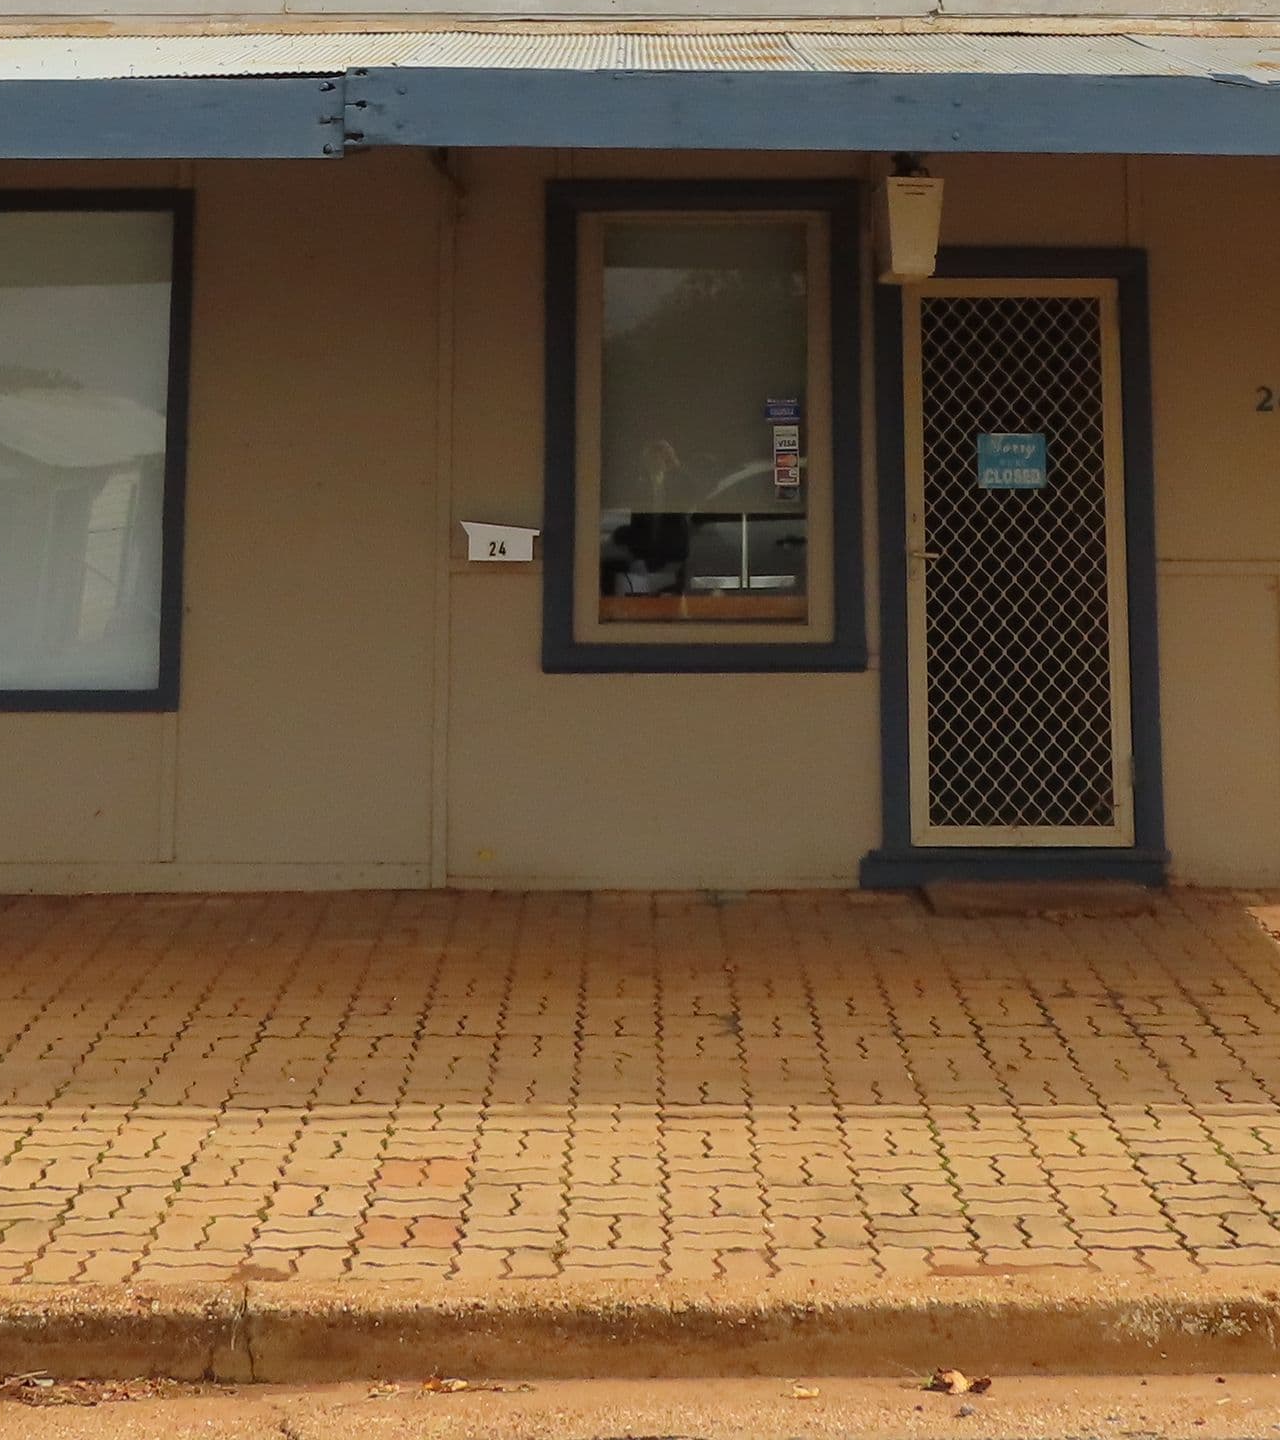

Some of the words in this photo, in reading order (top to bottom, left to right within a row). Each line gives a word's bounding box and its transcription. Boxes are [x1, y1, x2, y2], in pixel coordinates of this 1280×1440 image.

[777, 439, 797, 447] VISA
[983, 468, 1041, 483] CLOSED
[489, 541, 506, 557] 24
